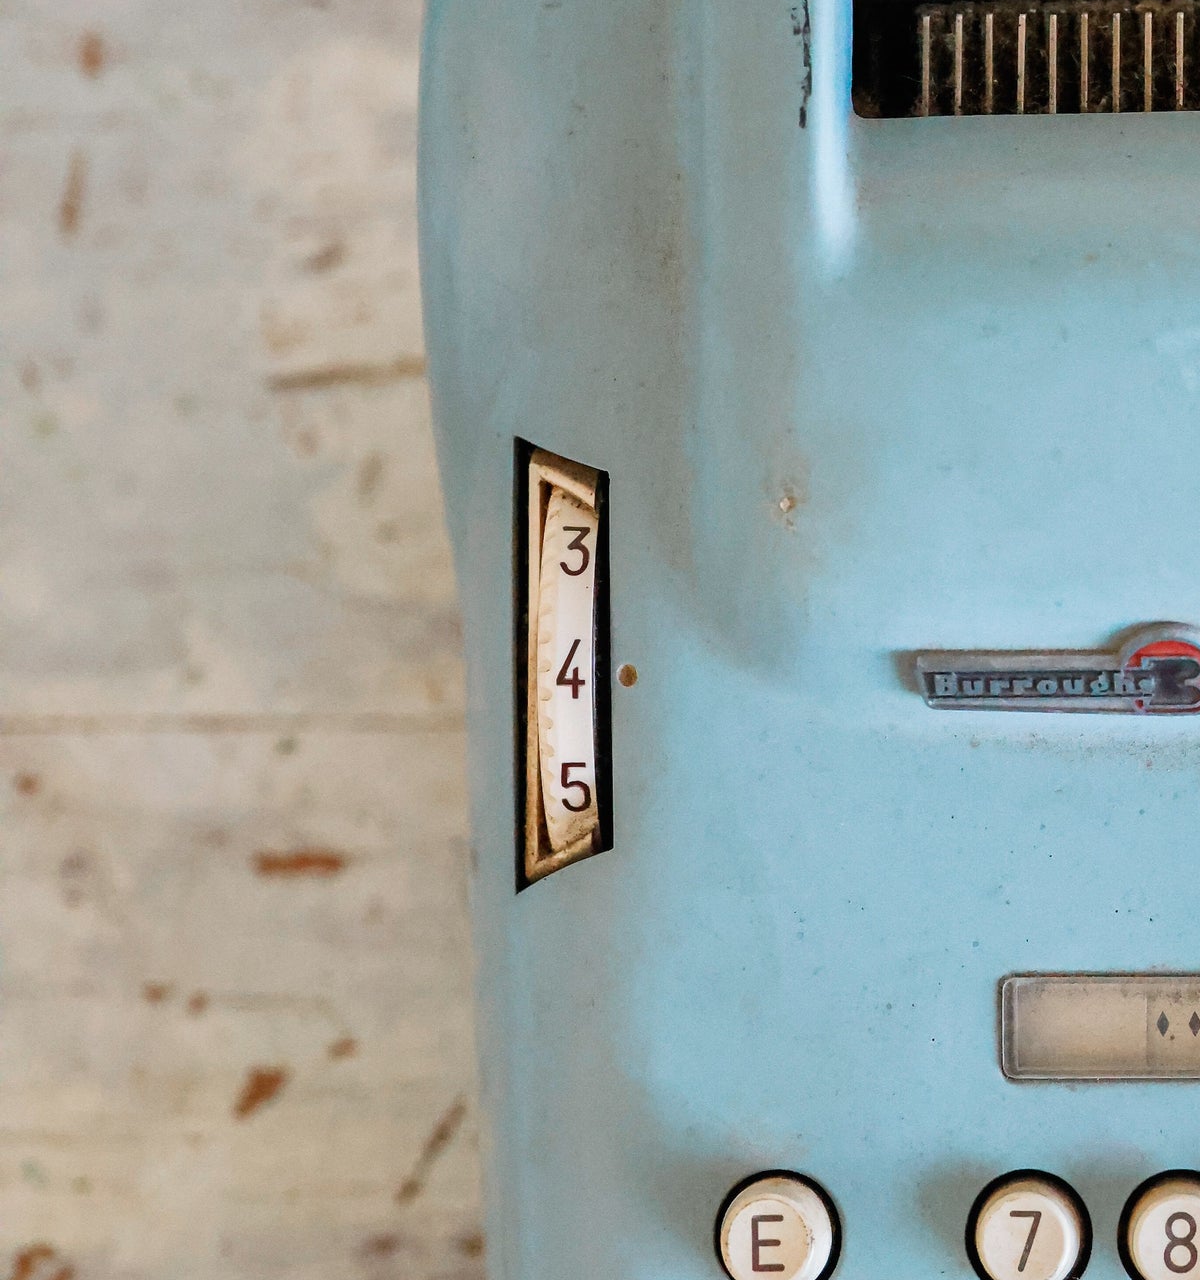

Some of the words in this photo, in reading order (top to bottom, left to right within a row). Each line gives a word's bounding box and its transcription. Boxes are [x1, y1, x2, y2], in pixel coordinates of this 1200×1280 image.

[560, 526, 591, 577] 3
[556, 639, 586, 700] 4
[932, 671, 1154, 696] Burroughs
[560, 761, 591, 812] 5
[751, 1214, 785, 1272] E
[1009, 1210, 1042, 1273] 7
[1163, 1211, 1198, 1274] 8
